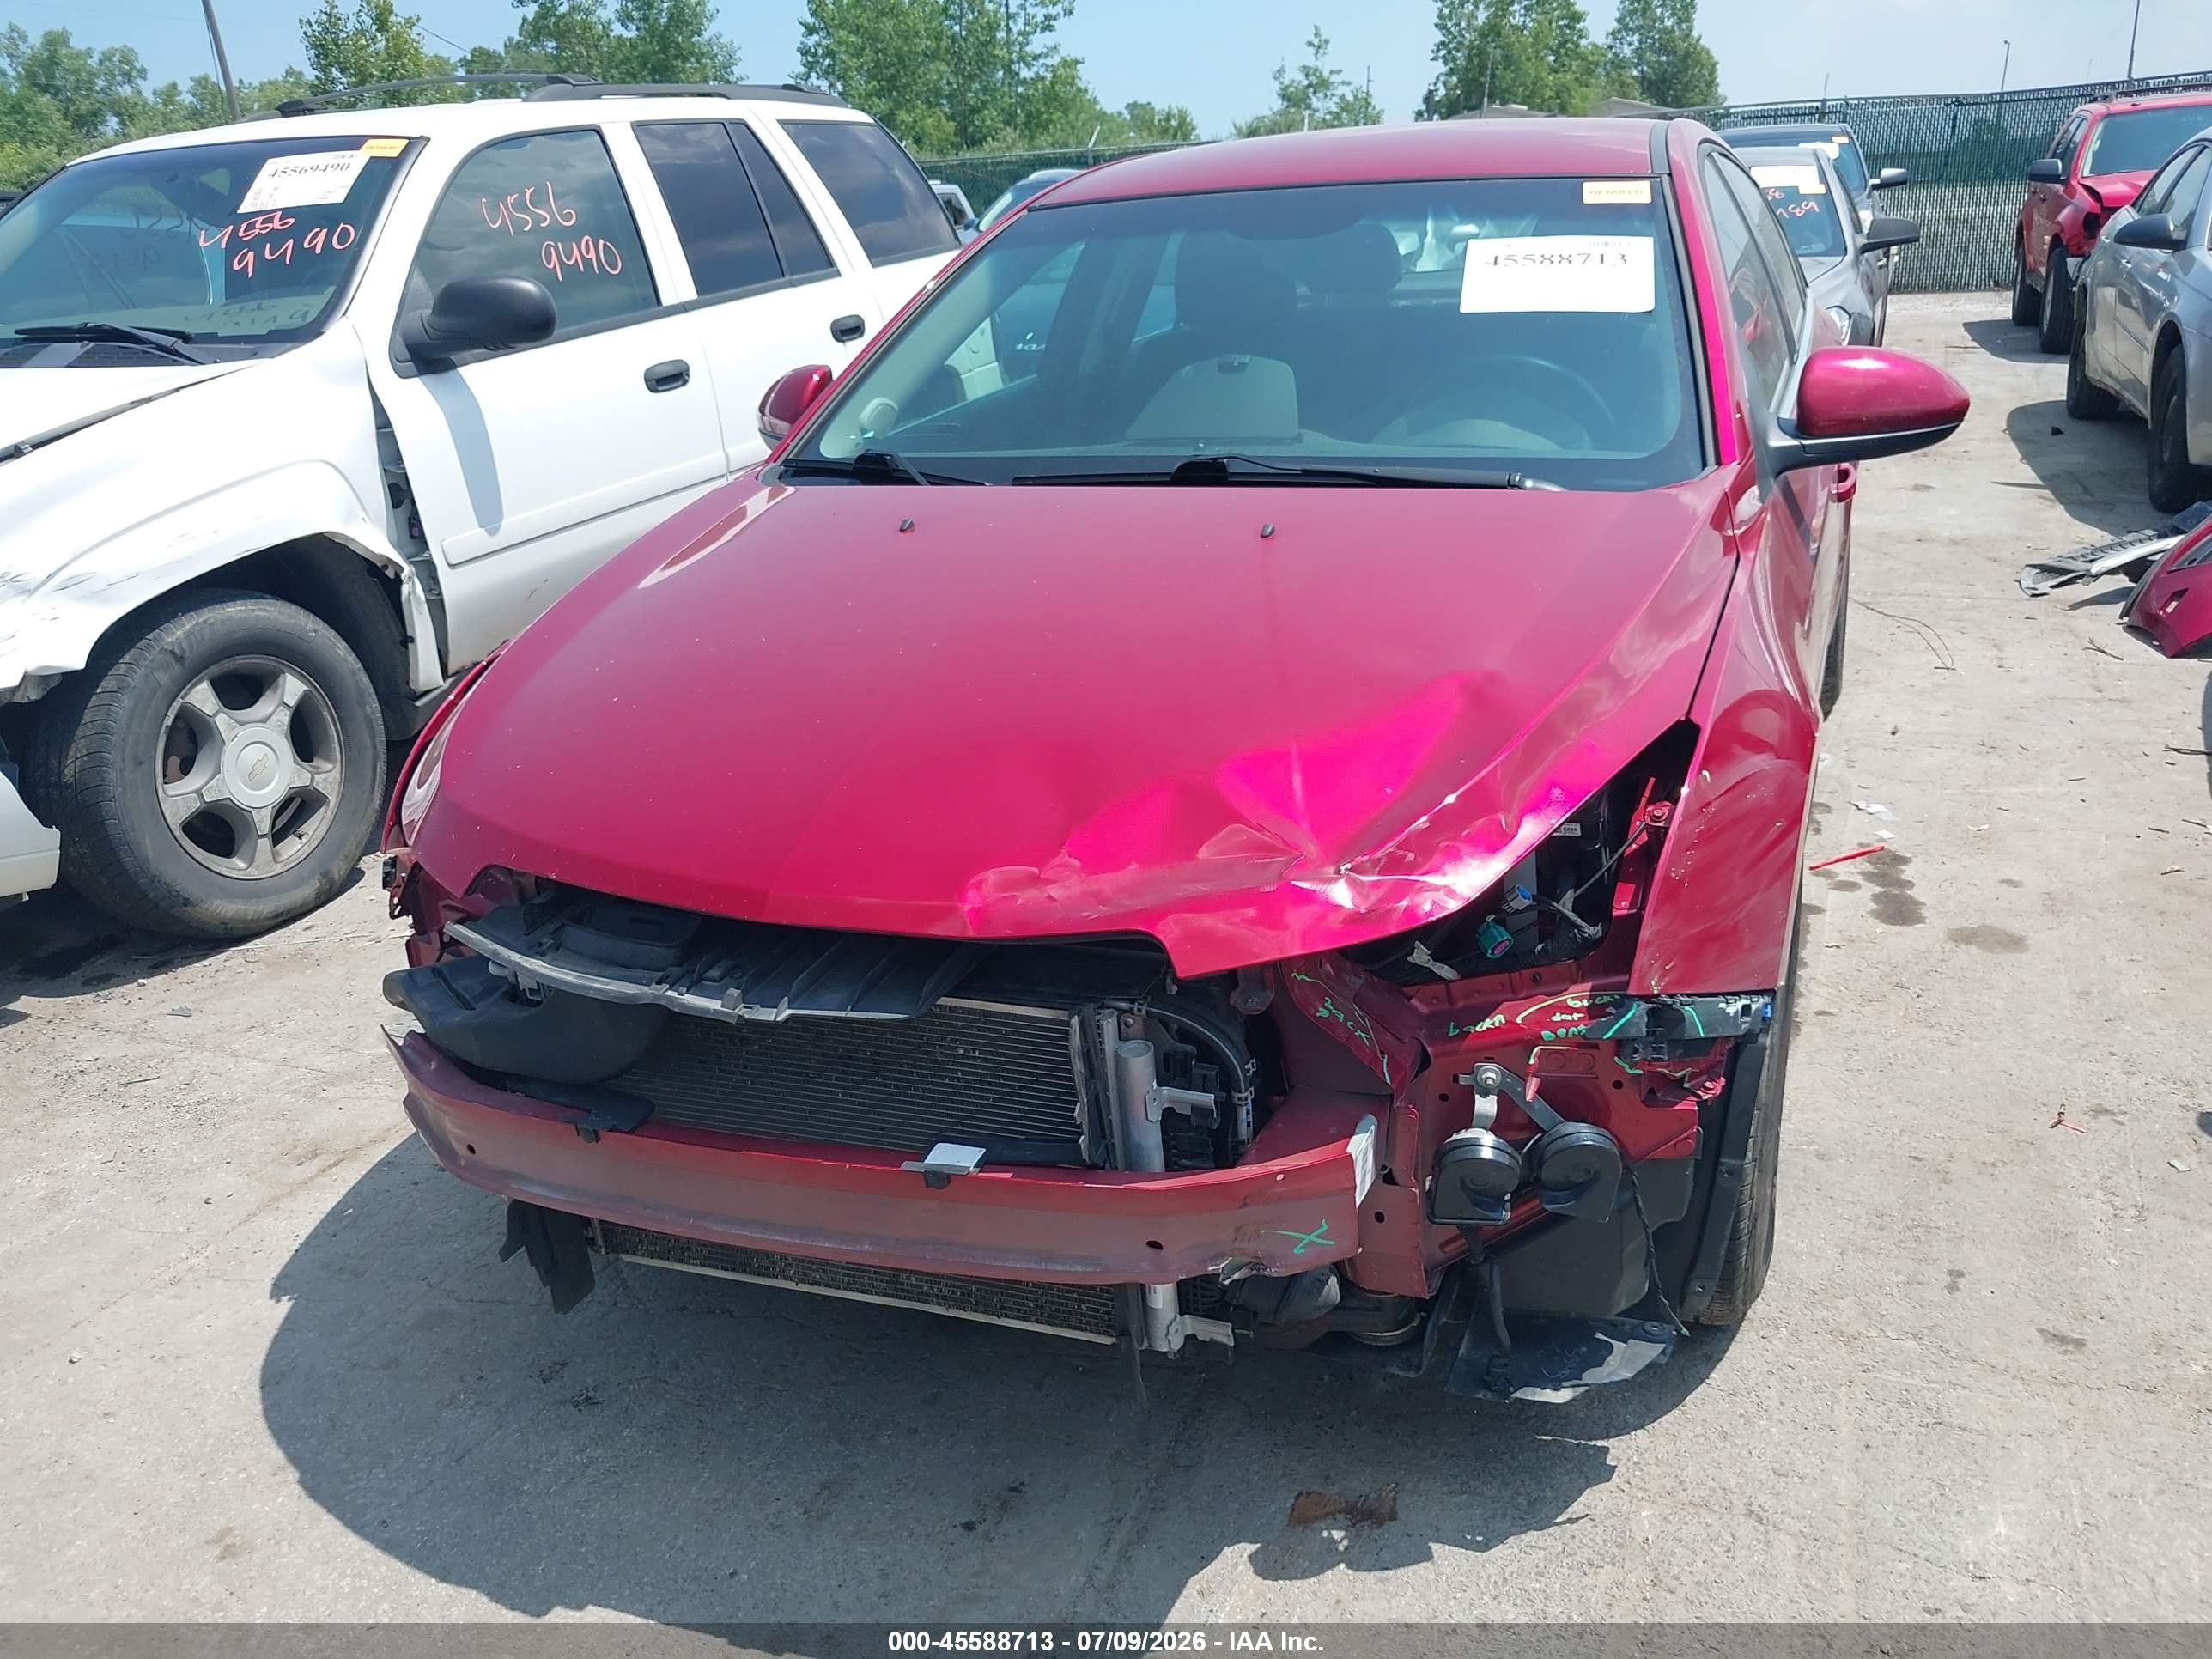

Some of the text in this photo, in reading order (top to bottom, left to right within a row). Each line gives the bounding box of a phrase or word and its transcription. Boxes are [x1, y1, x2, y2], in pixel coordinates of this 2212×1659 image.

[267, 162, 351, 179] 45569490
[480, 181, 576, 236] 4556
[198, 210, 296, 249] 4556
[233, 222, 356, 278] 9490
[541, 237, 622, 281] 9490
[1484, 253, 1627, 267] 45588713
